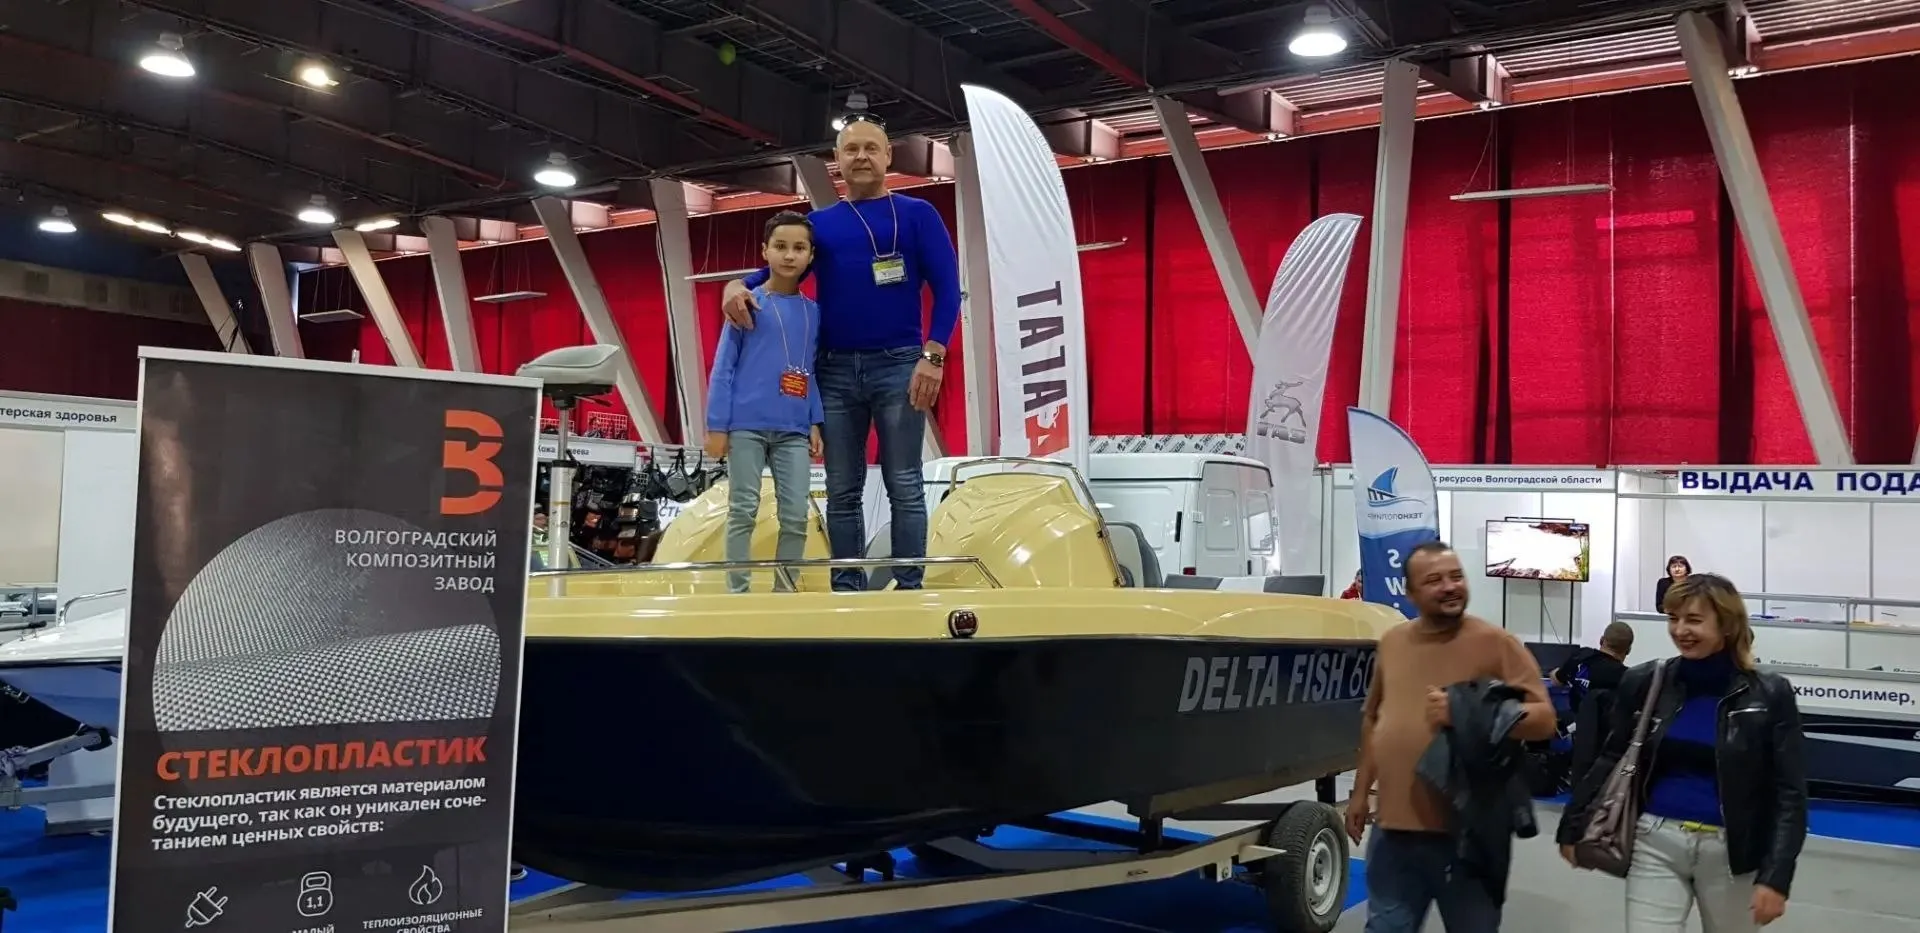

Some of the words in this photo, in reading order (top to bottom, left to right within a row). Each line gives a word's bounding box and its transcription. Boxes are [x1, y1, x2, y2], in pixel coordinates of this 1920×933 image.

[0, 407, 51, 419] терская
[55, 411, 117, 423] здоровья
[1439, 475, 1482, 484] ресурсов
[1485, 474, 1558, 485] Волгоградской
[1561, 474, 1602, 484] области
[1682, 471, 1814, 494] ВЫДАЧА
[1836, 472, 1920, 496] ПОДА
[335, 528, 497, 547] ВОЛГОГРАДСКИЙ
[346, 551, 496, 570] КОМПОЗИТНЫЙ
[434, 575, 495, 594] ЗАВОД
[1178, 655, 1279, 712] DELTA
[1286, 653, 1347, 703] FISH
[1793, 685, 1916, 705] хнополимер,
[156, 735, 488, 781] СТЕКЛОПЛАСТИК
[154, 786, 297, 811] Стеклопластик
[299, 782, 378, 801] является
[381, 776, 486, 797] материалом
[152, 810, 253, 832] будущего,
[259, 808, 289, 823] так
[294, 805, 326, 820] как
[330, 803, 352, 818] он
[356, 797, 440, 820] уникален
[444, 793, 487, 809] соче-
[152, 832, 227, 852] танием
[232, 826, 303, 848] ценных
[308, 819, 384, 838] свойств:
[306, 895, 324, 909] 1,1
[363, 908, 484, 930] ТЕПЛОИЗОЛЯЦИОННЫЕ
